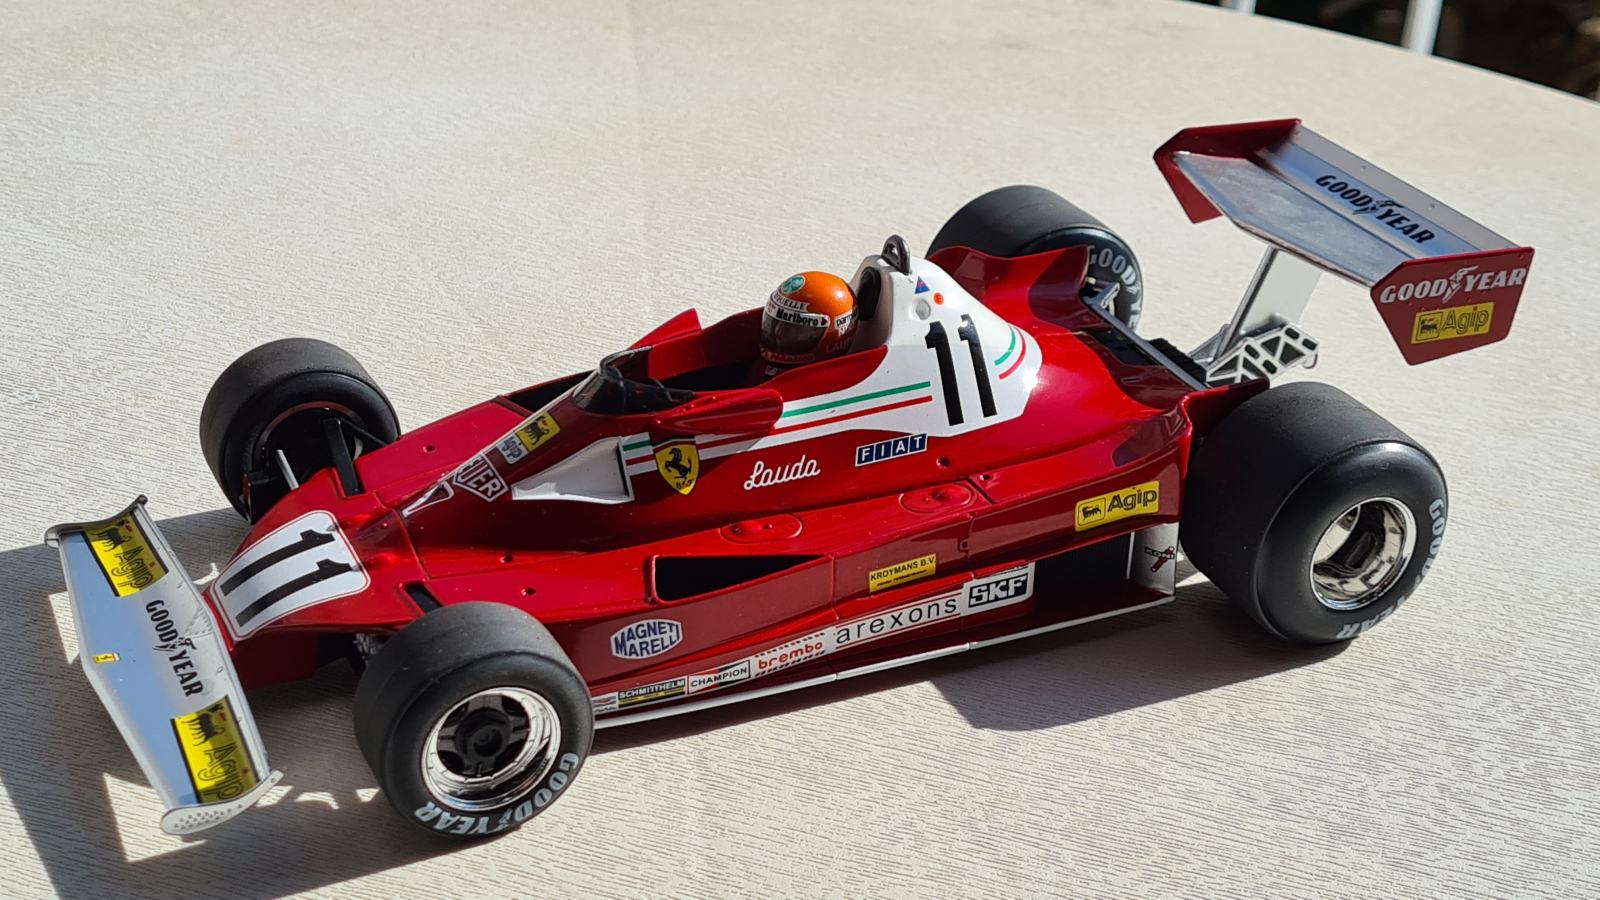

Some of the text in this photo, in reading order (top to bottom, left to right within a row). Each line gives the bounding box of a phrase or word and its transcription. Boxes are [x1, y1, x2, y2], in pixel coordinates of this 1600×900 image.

[776, 308, 819, 326] Marlboro
[1442, 306, 1489, 335] Agip
[924, 313, 998, 427] 11
[859, 436, 925, 463] FIAT
[744, 454, 821, 491] Lauda
[1107, 488, 1158, 513] Agip
[220, 529, 353, 628] 11
[870, 561, 918, 581] KROYMANS
[969, 575, 1027, 607] SKF
[614, 621, 680, 644] MAGNETI
[836, 599, 957, 644] arexons
[758, 642, 823, 669] brembo
[691, 667, 748, 688] CHAMPION
